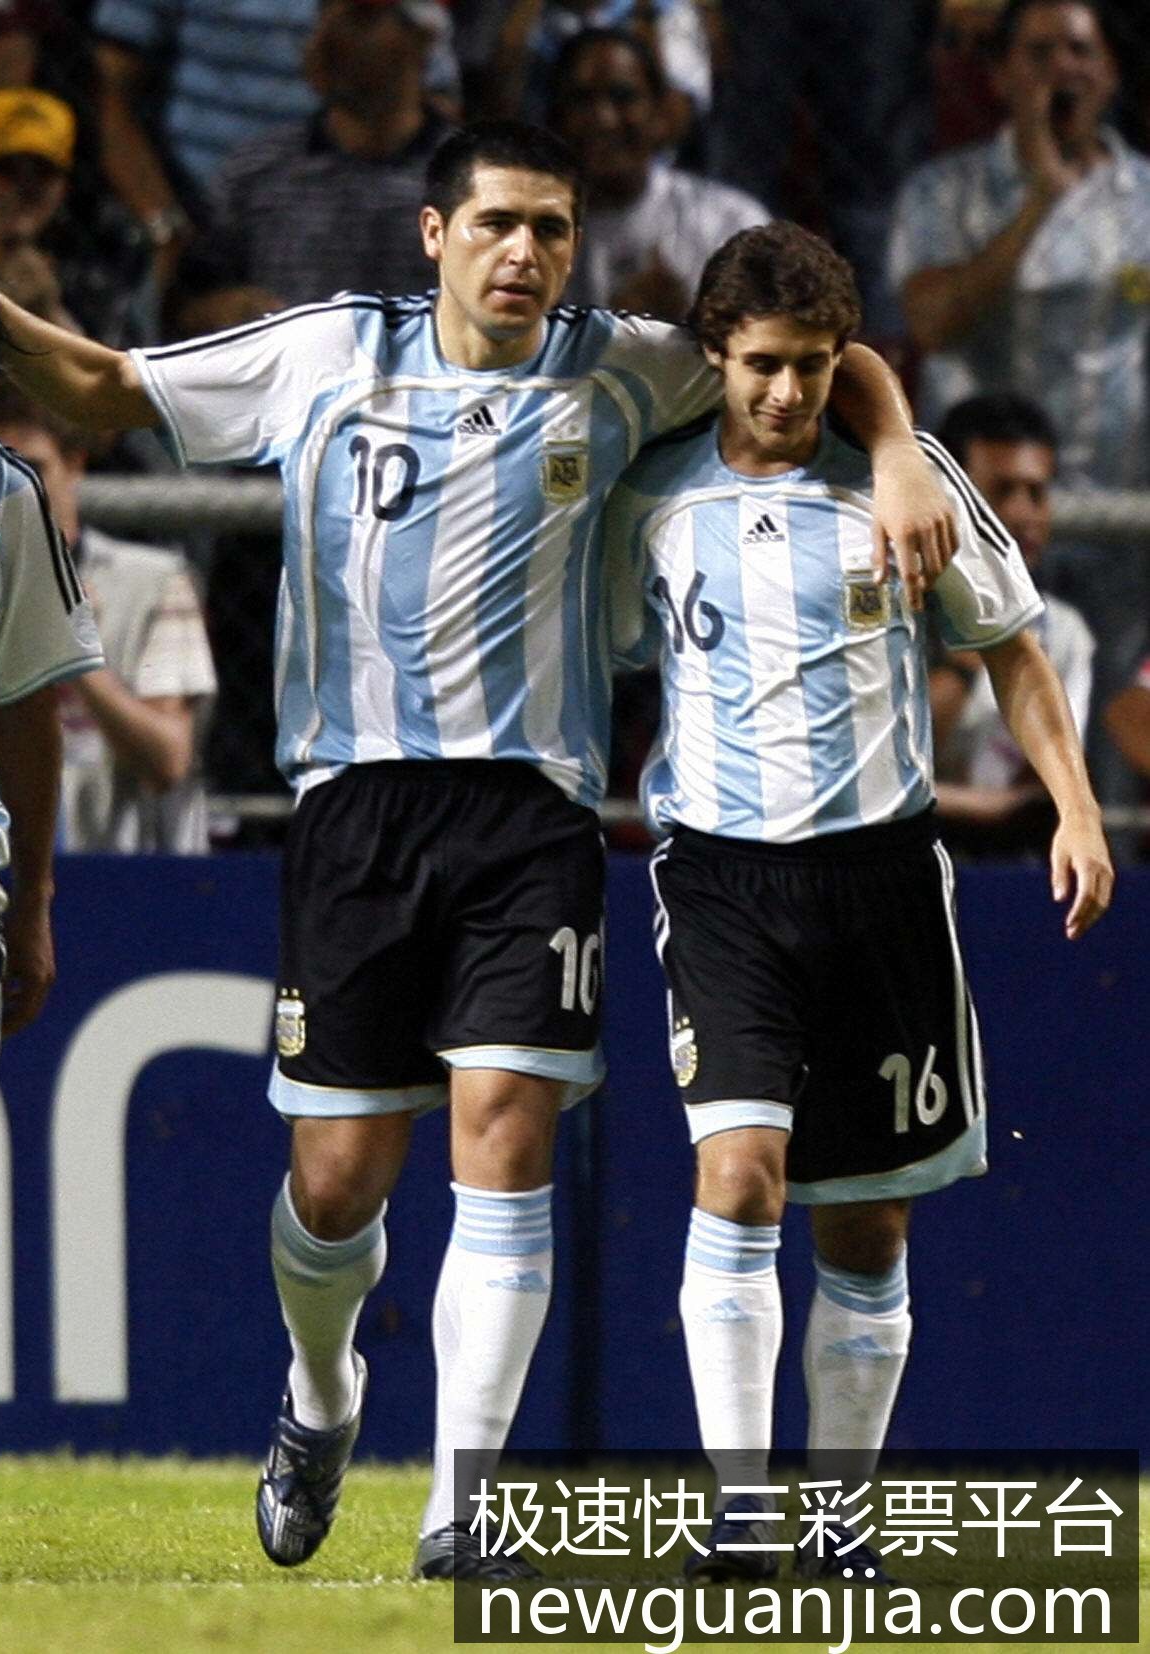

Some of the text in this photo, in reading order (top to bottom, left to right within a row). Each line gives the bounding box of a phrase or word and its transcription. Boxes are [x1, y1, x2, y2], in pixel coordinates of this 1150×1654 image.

[350, 435, 420, 521] 10
[652, 569, 724, 653] 16
[879, 1045, 948, 1134] 16
